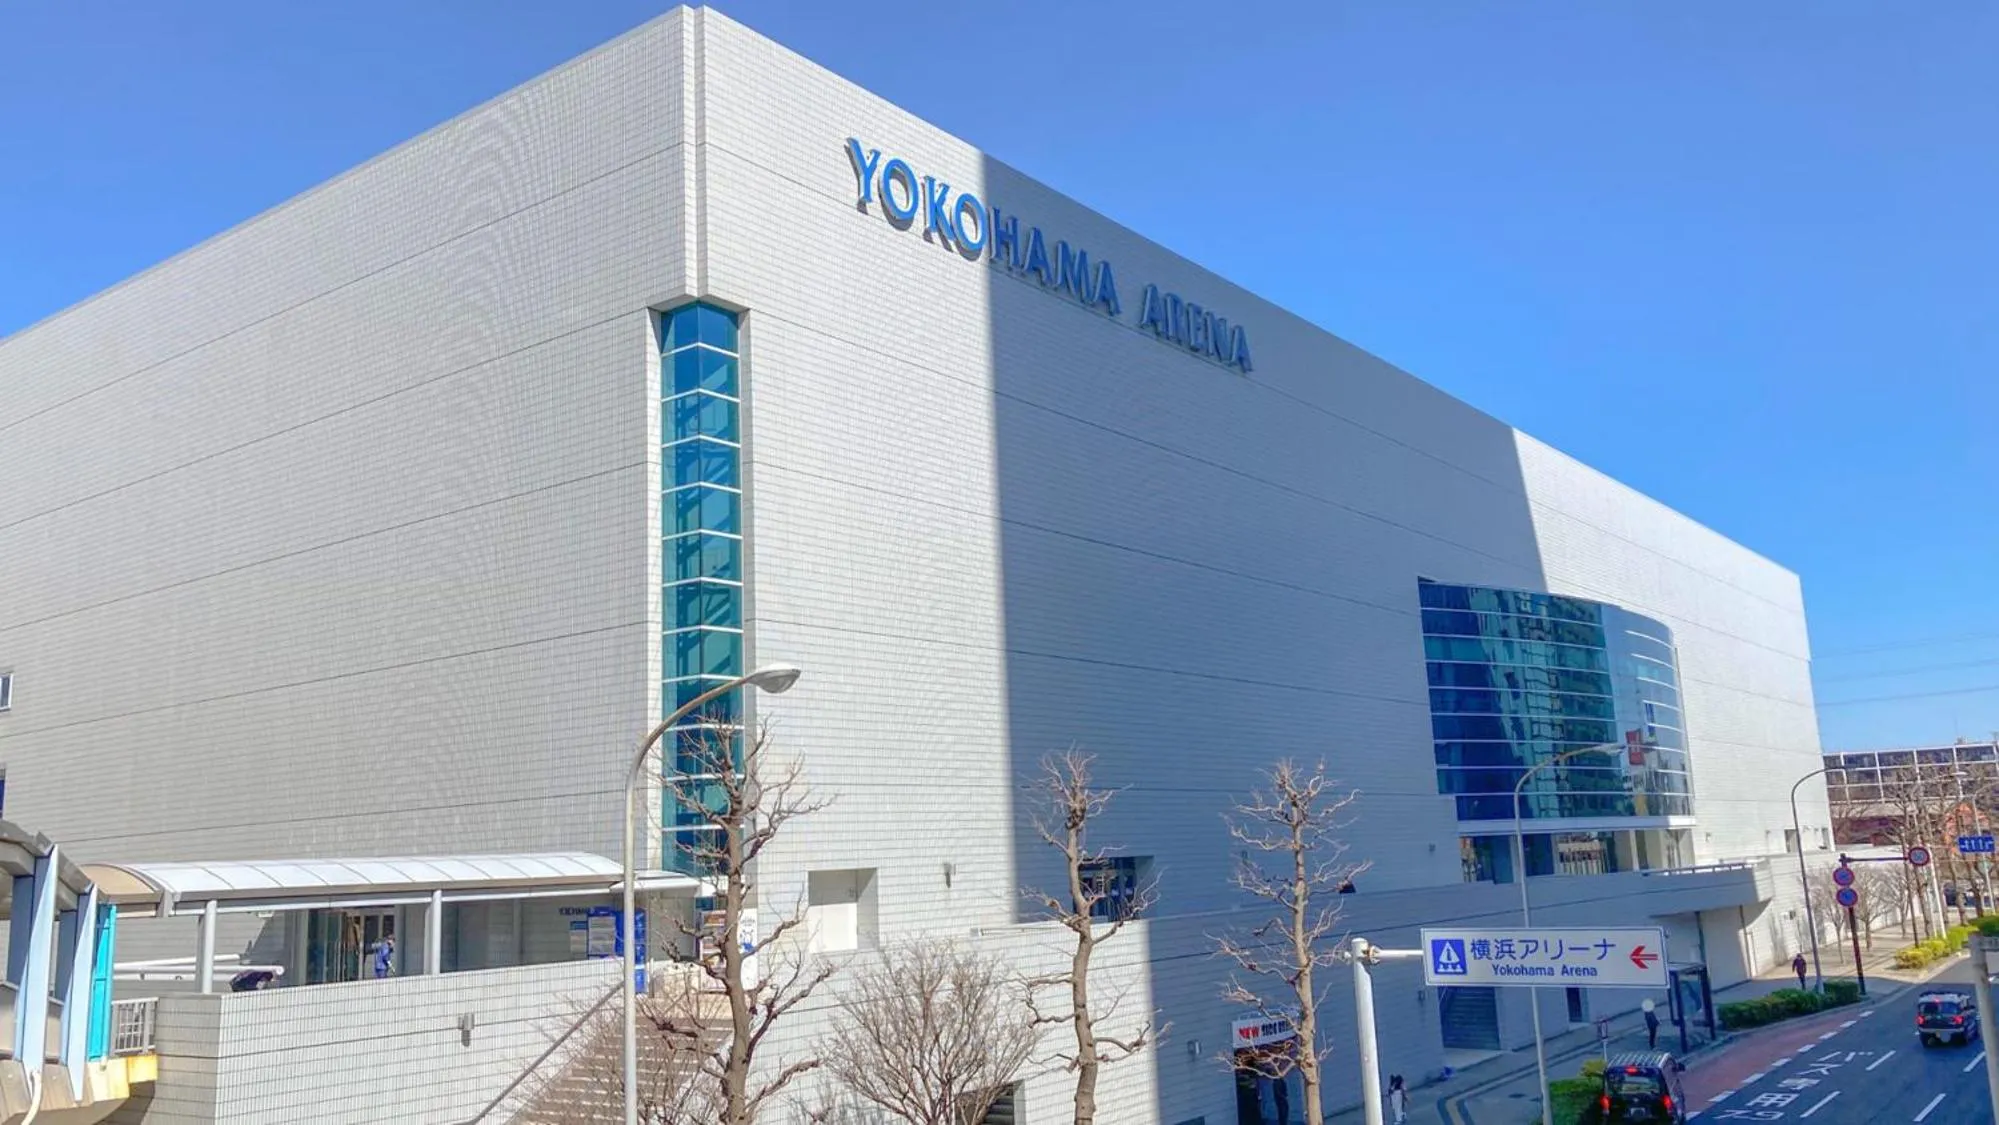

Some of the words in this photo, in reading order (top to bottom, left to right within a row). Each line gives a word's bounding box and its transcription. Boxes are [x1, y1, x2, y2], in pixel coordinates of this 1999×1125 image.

[846, 137, 1121, 316] YOKOHAMA
[1139, 284, 1254, 372] ARENA
[1471, 938, 1616, 961] 横浜アリーナ
[1492, 964, 1555, 977] Yokohama
[1561, 964, 1598, 977] Arena
